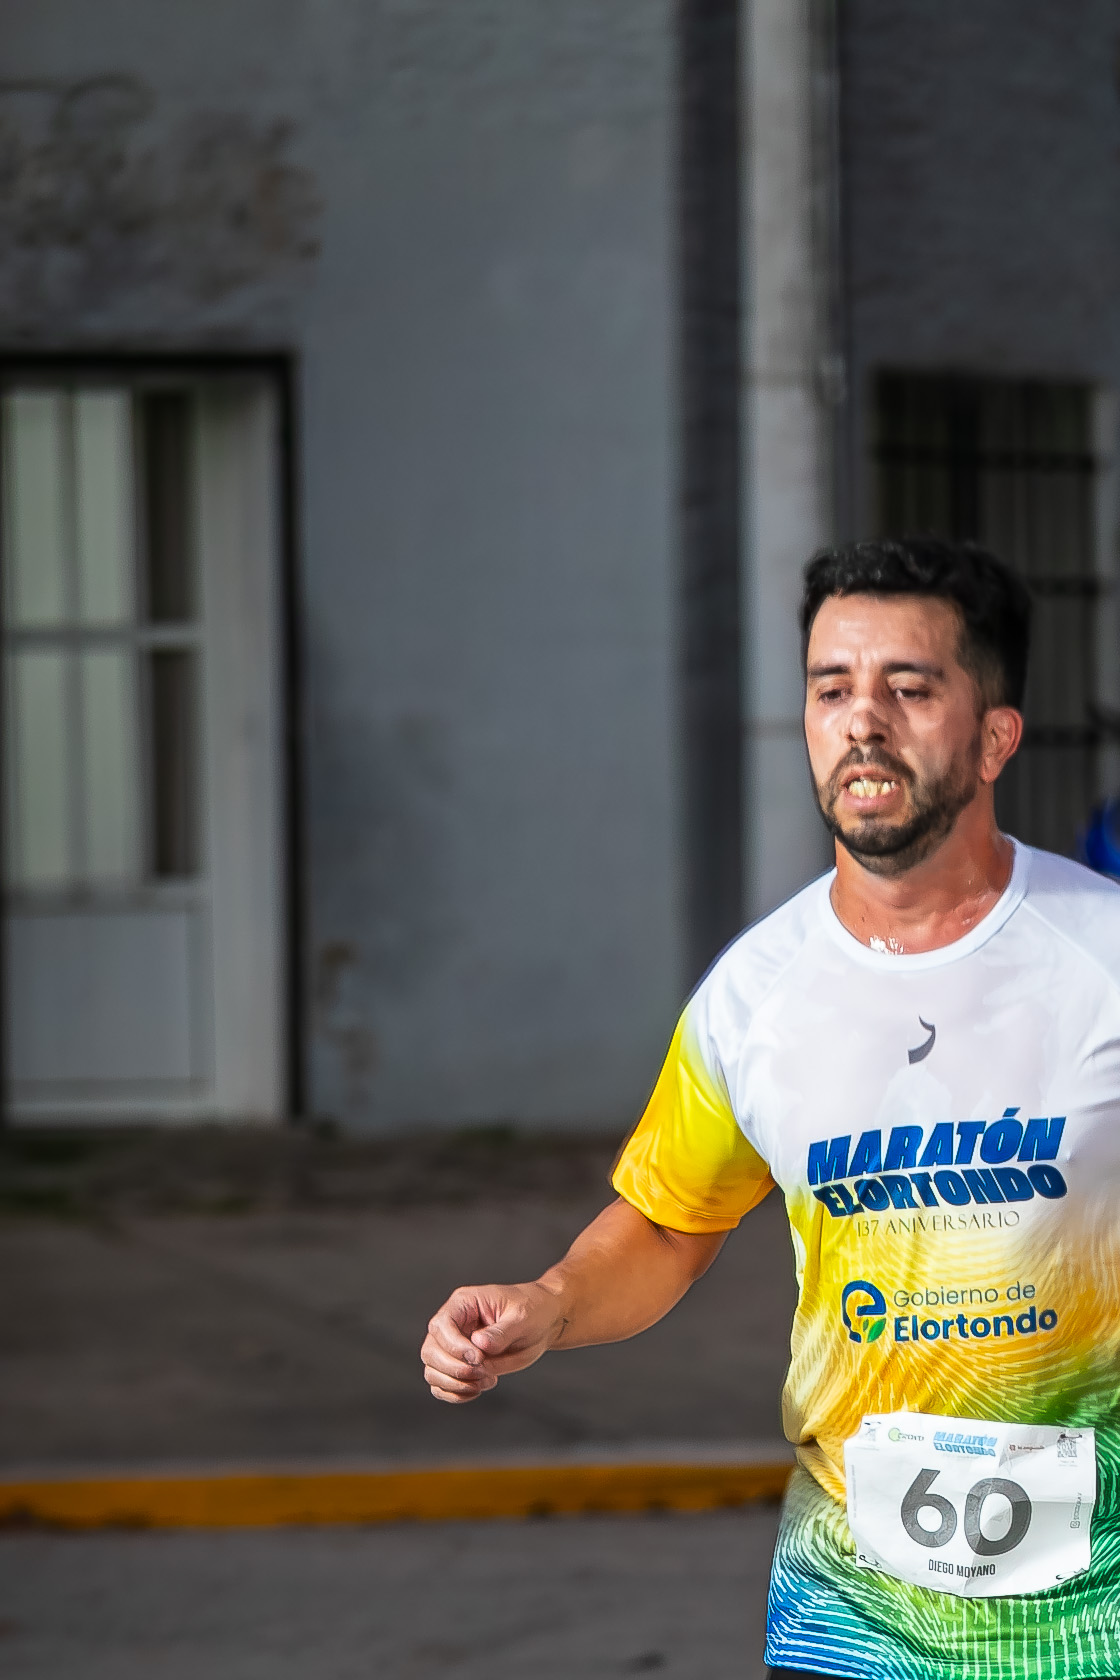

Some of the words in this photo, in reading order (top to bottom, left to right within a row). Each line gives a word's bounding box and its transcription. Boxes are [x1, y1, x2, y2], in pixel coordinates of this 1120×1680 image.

[806, 1107, 1067, 1186] MARATÓN
[812, 1164, 1068, 1218] ELORTONDO
[857, 1219, 879, 1237] 137
[885, 1210, 1020, 1235] ANIVERSARIO
[893, 1286, 998, 1308] Gobierno
[1005, 1281, 1037, 1301] de
[893, 1306, 1058, 1342] Elortondo
[901, 1468, 1032, 1556] 60
[928, 1559, 954, 1575] DIEGO
[956, 1563, 996, 1578] MOYANO
